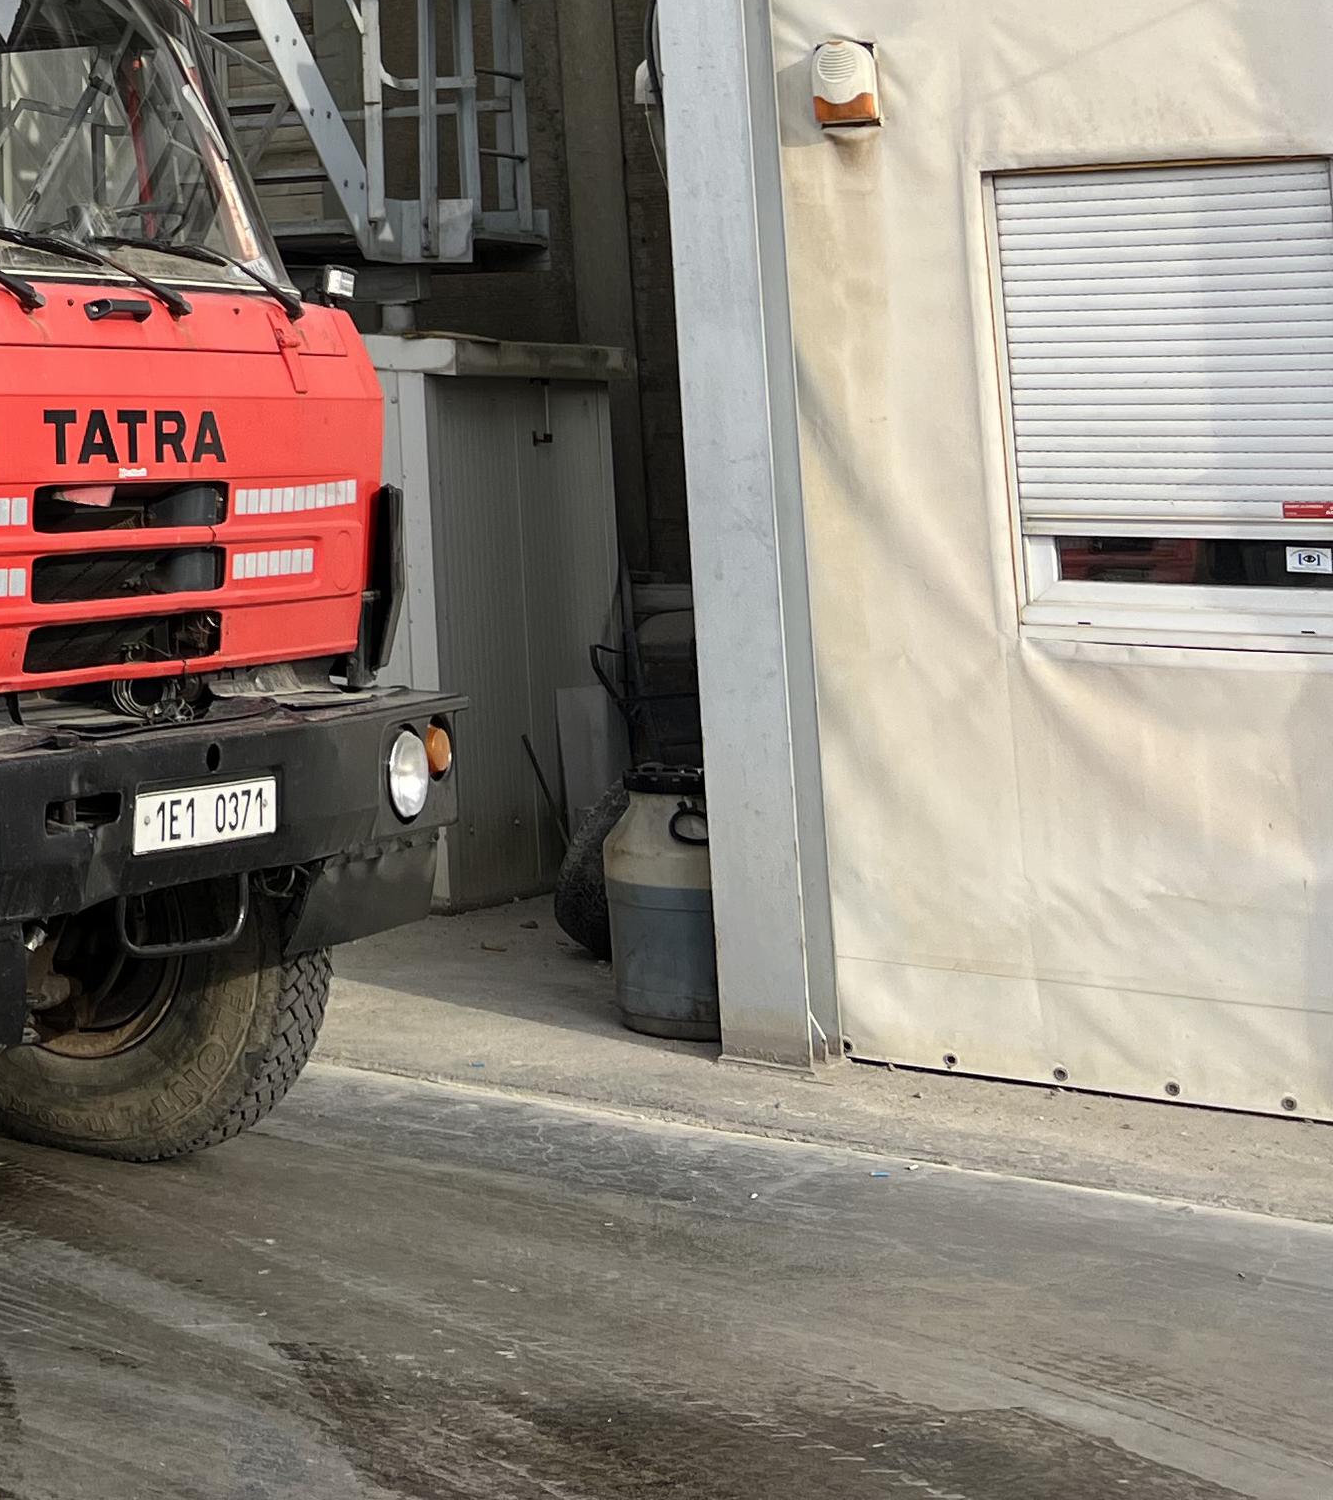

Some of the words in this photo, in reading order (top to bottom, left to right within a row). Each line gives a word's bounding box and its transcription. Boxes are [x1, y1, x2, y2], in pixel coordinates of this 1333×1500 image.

[43, 409, 227, 464] TATRA
[156, 797, 195, 842] 1E1
[215, 787, 263, 833] 0371
